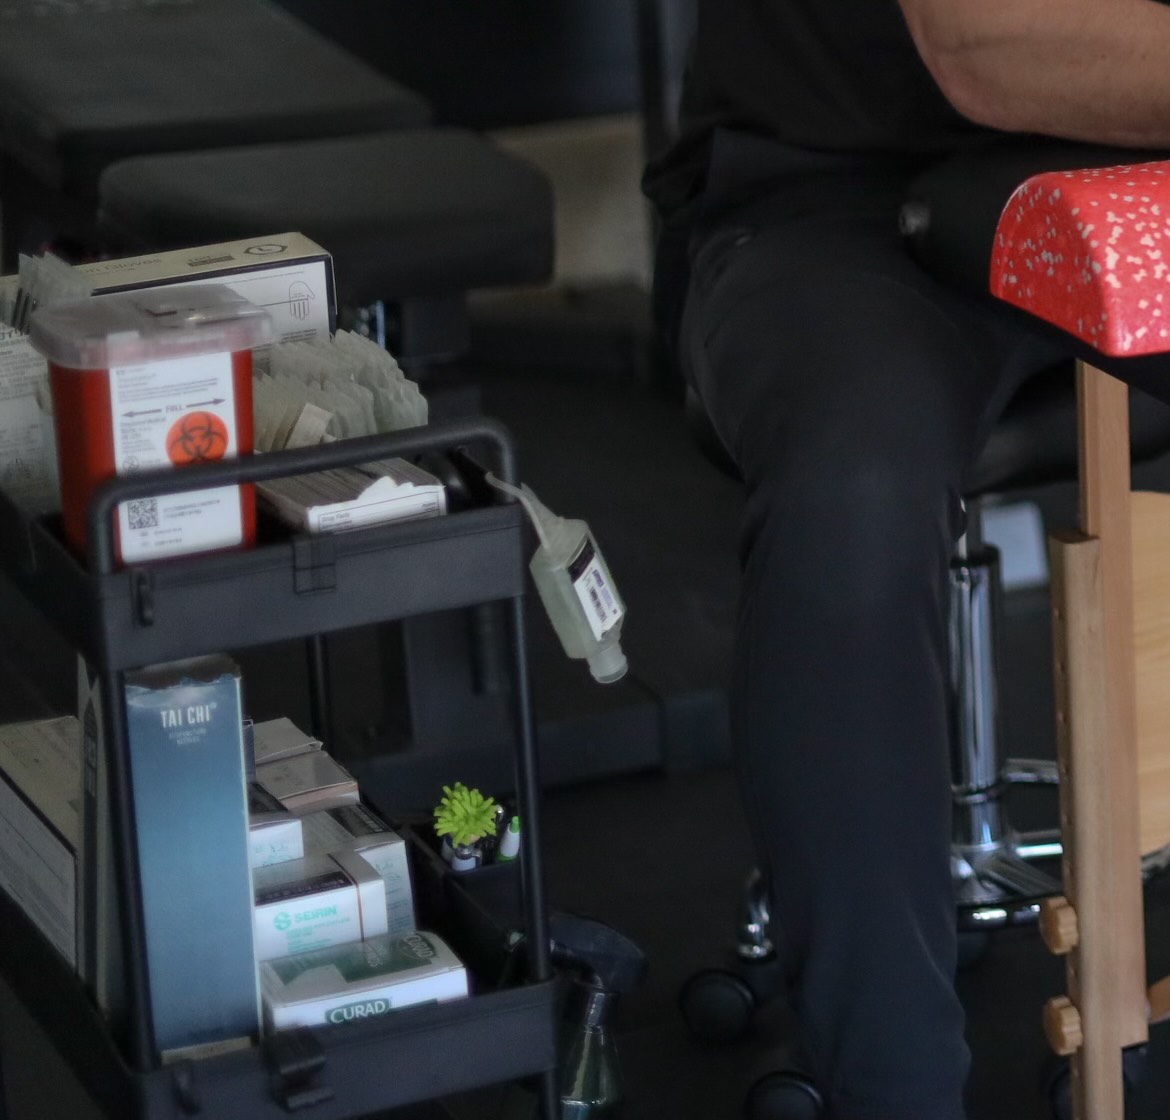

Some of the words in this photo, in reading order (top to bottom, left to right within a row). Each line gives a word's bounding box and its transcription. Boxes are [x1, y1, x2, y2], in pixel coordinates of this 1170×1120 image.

[160, 708, 183, 728] TAI
[187, 704, 211, 724] CHI
[329, 1000, 387, 1024] CURAD
